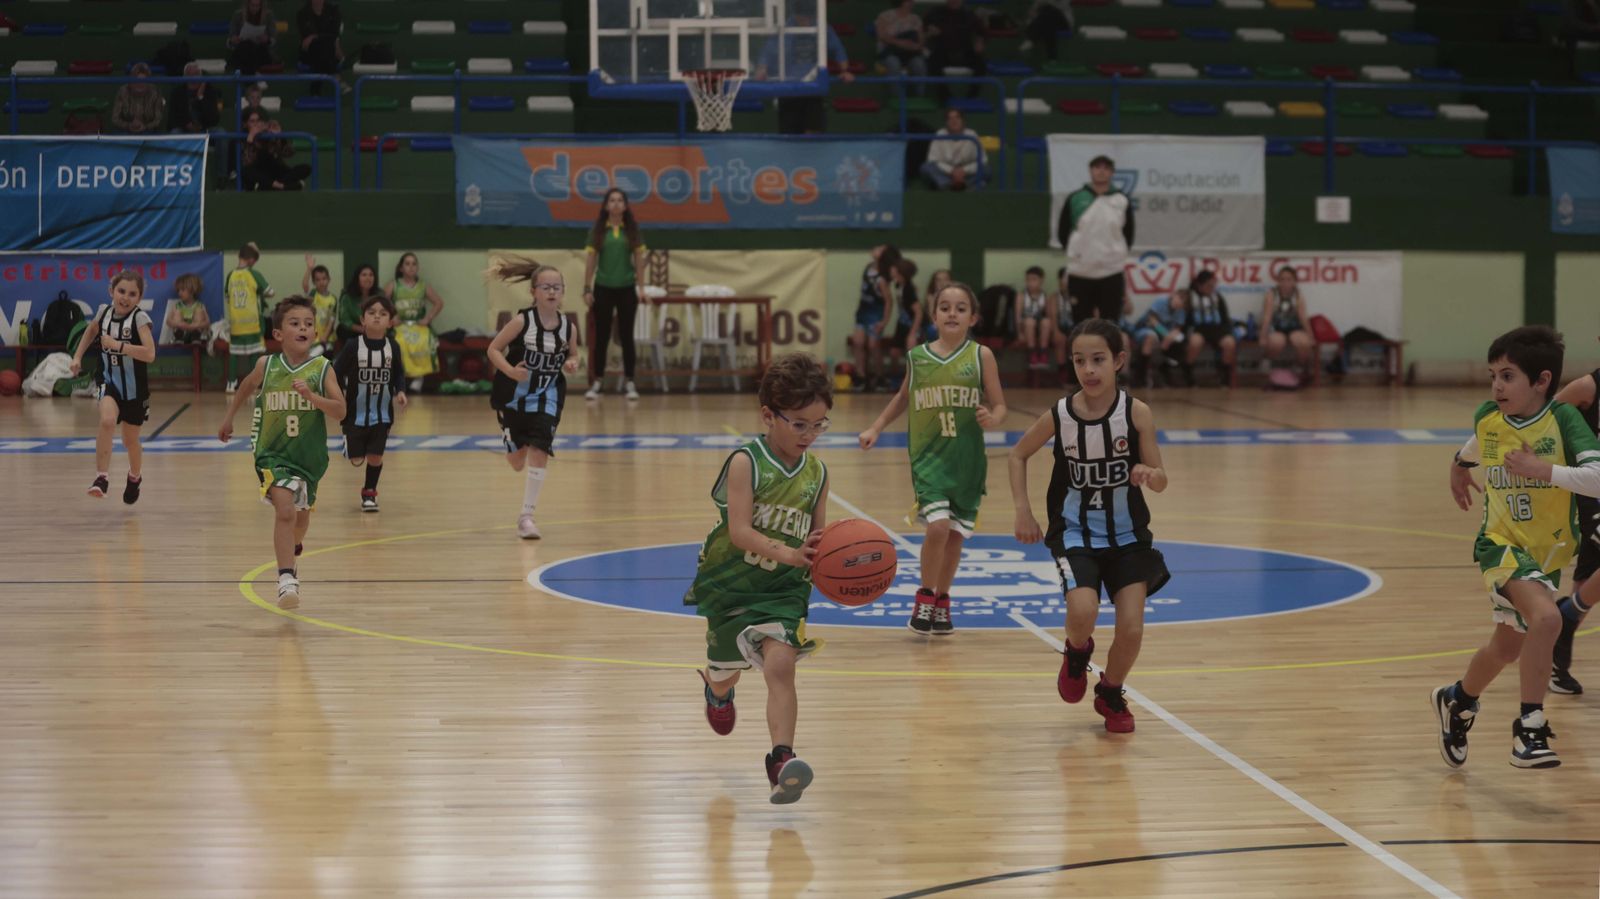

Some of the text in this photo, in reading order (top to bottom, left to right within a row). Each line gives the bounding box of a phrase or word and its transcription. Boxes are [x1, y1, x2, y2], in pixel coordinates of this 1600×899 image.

[57, 164, 193, 189] DEPORTES
[1148, 194, 1169, 213] de
[110, 354, 119, 367] 8
[358, 367, 392, 385] ULB
[913, 384, 980, 412] MONTERA
[286, 414, 300, 438] 8
[1067, 458, 1130, 489] ULB
[1088, 489, 1104, 509] 4
[1506, 492, 1533, 522] 16
